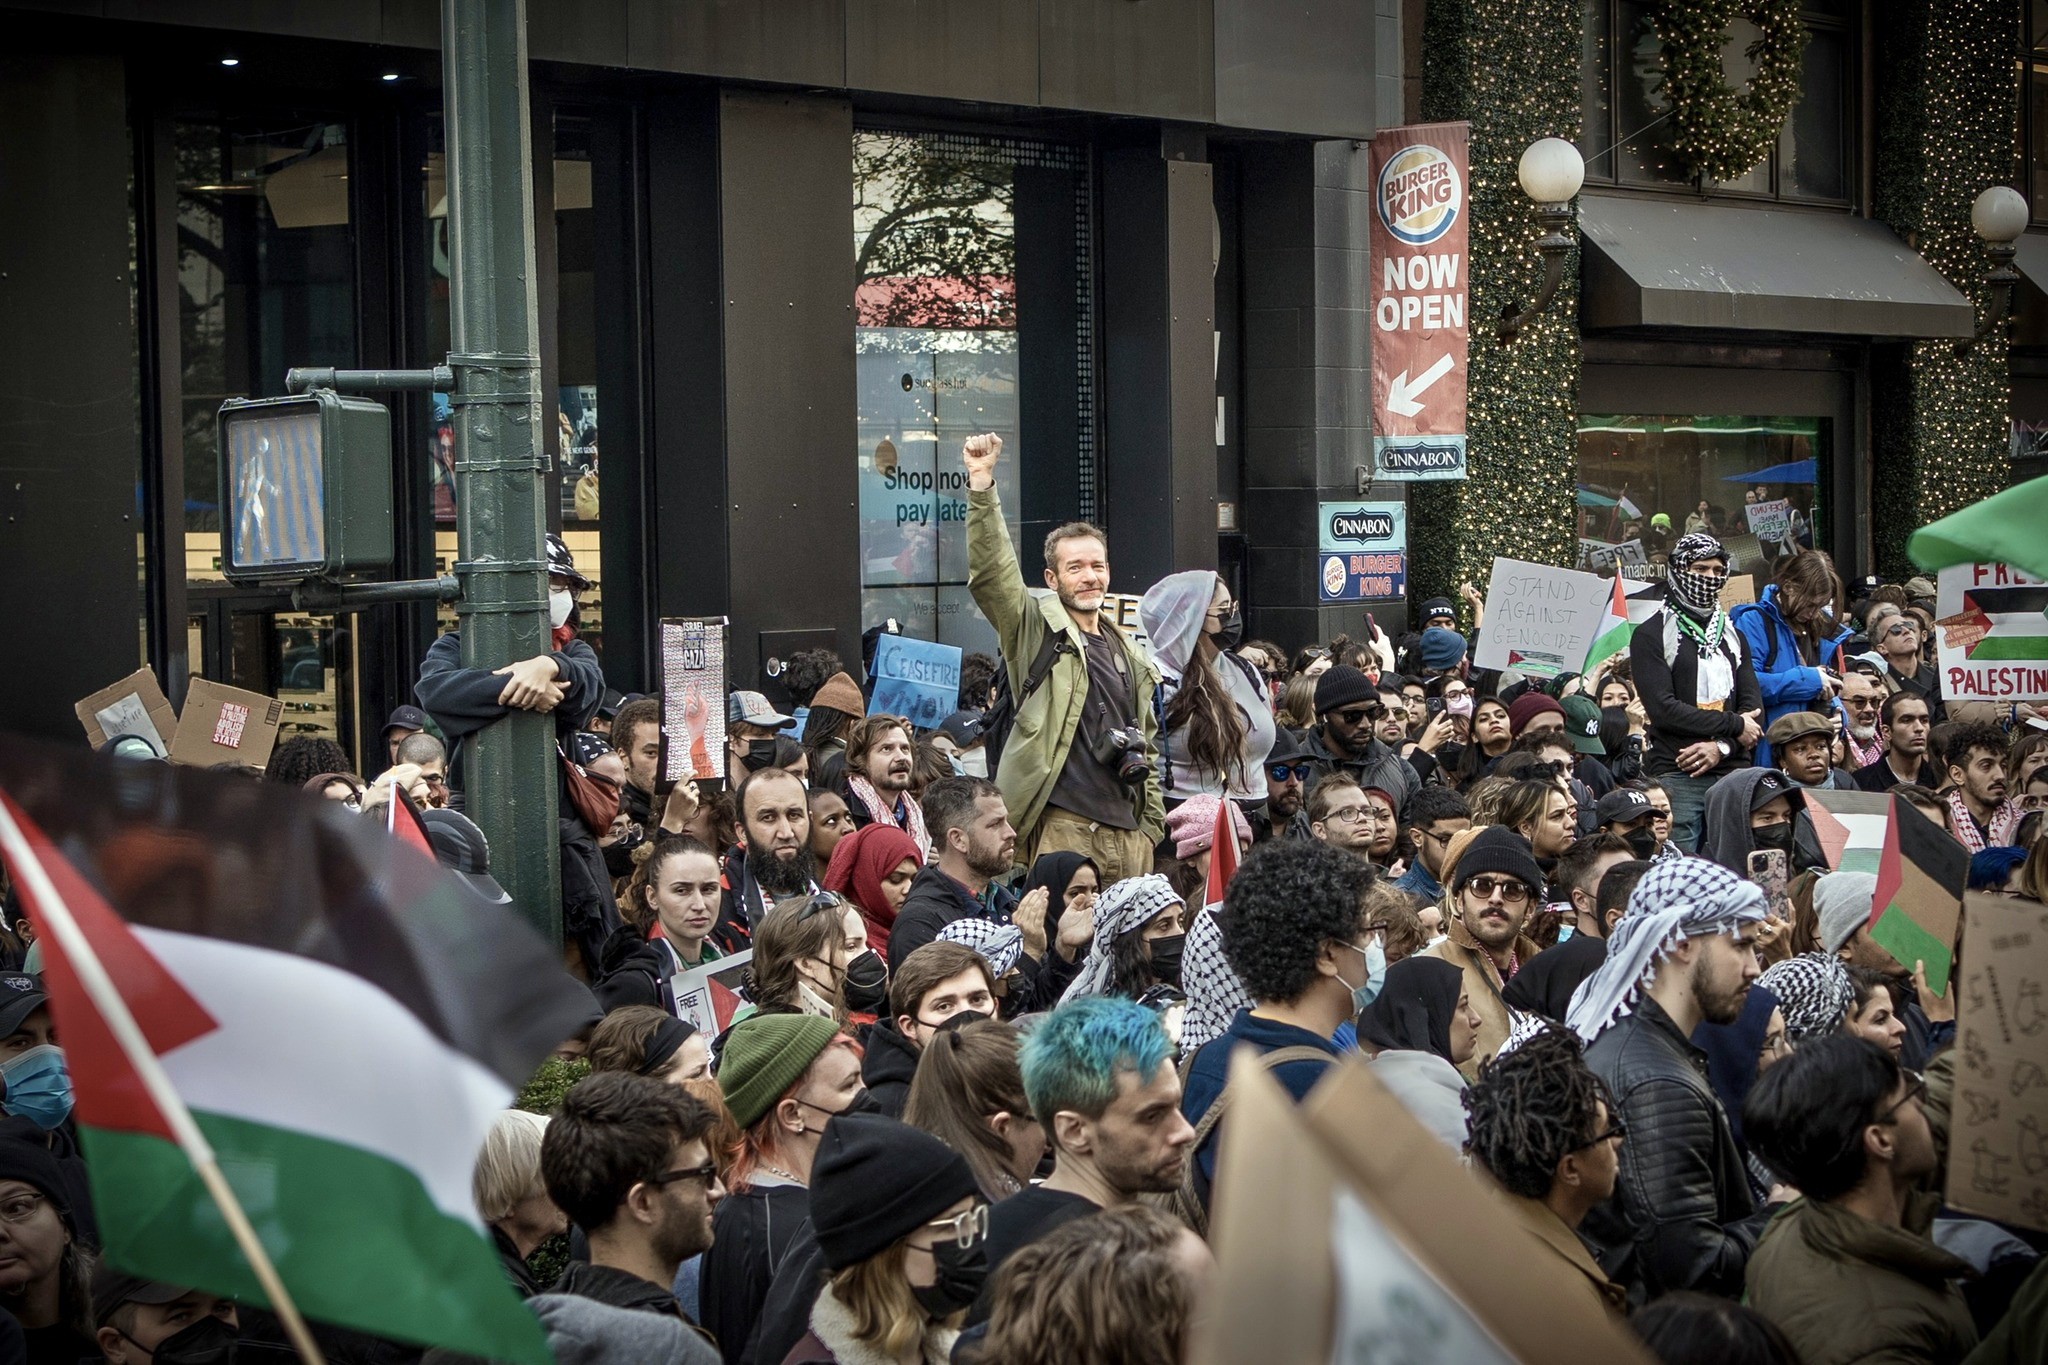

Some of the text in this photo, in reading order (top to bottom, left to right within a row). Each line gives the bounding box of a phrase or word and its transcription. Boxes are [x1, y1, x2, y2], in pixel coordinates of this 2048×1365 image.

[1385, 161, 1448, 201] BURGER
[1388, 178, 1452, 225] KING
[1384, 254, 1460, 291] NOW
[1377, 294, 1463, 332] OPEN
[1384, 450, 1457, 467] CINNABON
[884, 466, 933, 495] Shop
[896, 501, 930, 527] pay
[1334, 518, 1391, 536] CINNABON
[1350, 555, 1402, 575] BURGER
[1624, 560, 1666, 582] magic in
[1326, 571, 1344, 588] KING
[1360, 577, 1392, 596] KING
[1504, 576, 1576, 601] STAND
[1498, 598, 1578, 624] AGAINST
[682, 622, 704, 632] ISRAEL
[1493, 624, 1582, 650] GENOCIDE
[684, 650, 705, 670] GAZA
[884, 645, 958, 686] CEASEFIRE
[1948, 667, 2048, 696] PALESTIN
[1586, 719, 1598, 736] NY
[213, 734, 240, 748] STATE
[1628, 791, 1646, 804] NY
[680, 996, 698, 1010] FREE
